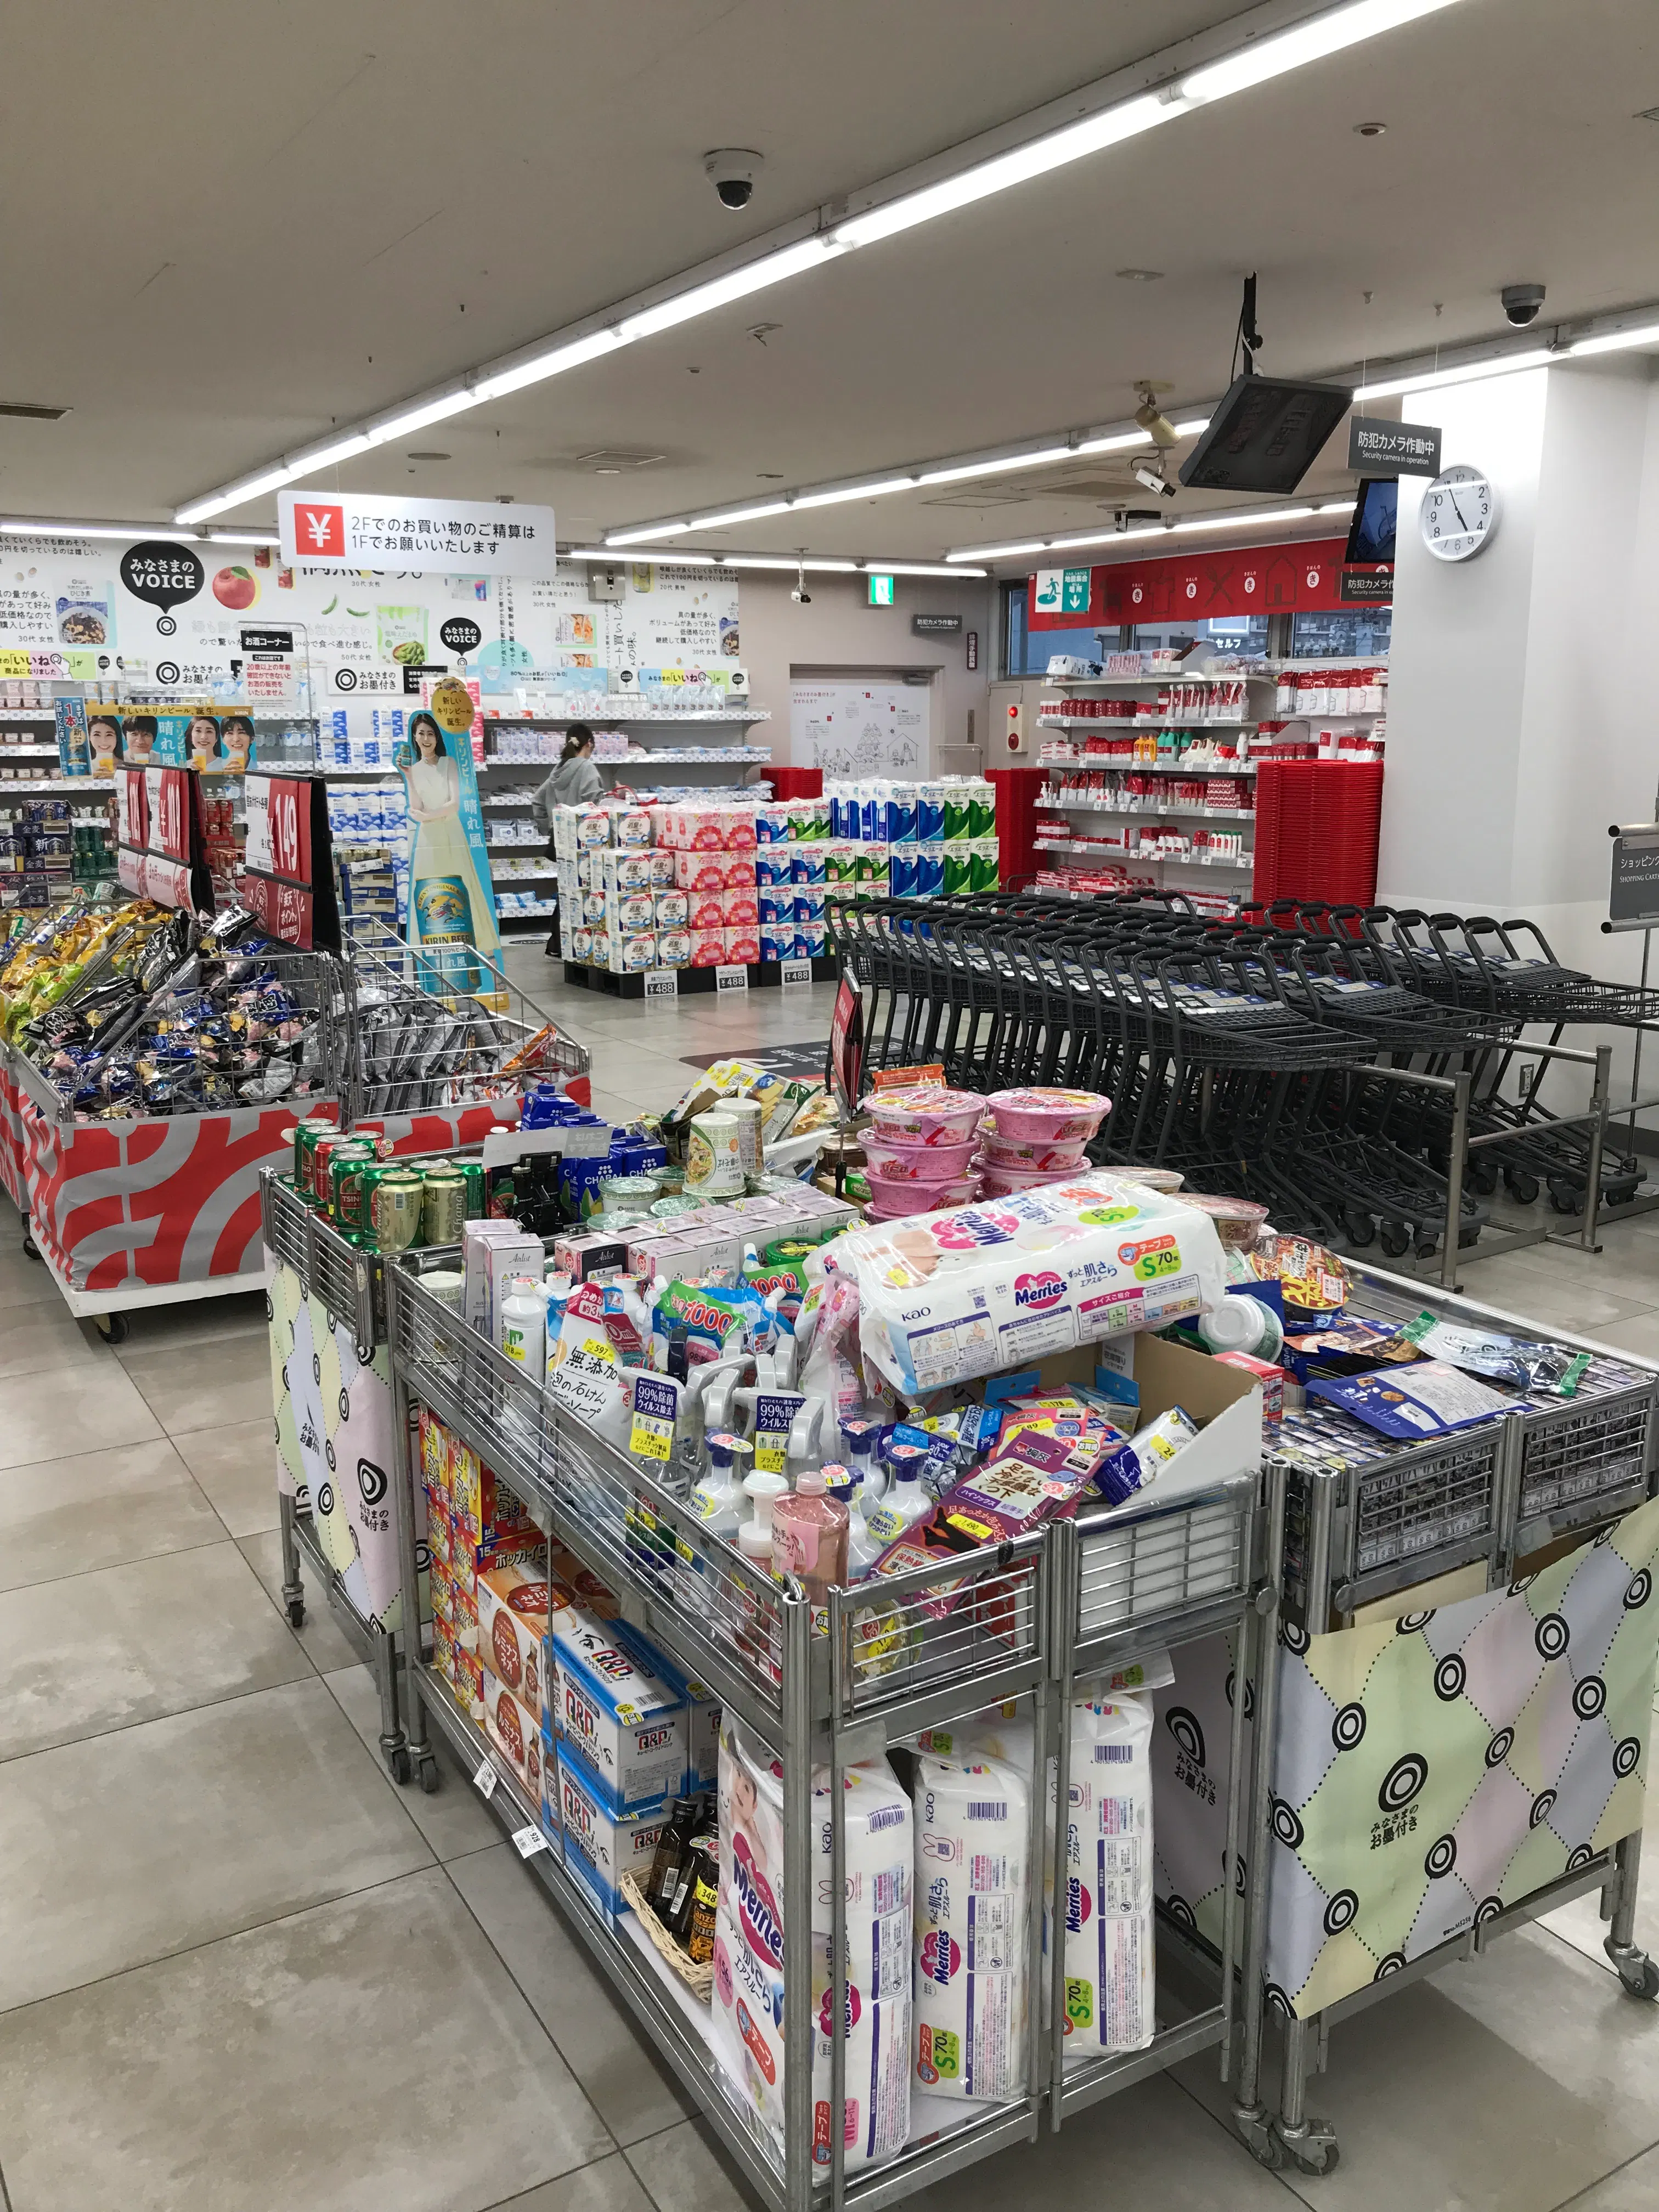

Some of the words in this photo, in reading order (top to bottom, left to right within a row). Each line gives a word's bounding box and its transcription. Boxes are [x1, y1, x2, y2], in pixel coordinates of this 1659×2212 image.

[1358, 431, 1434, 456] 防犯カメラ作動中
[1362, 450, 1381, 461] Security
[1434, 495, 1443, 506] 10
[1481, 503, 1488, 515] 3
[1431, 511, 1437, 522] 9
[352, 516, 535, 539] 2Fでのお買い物のご精算は
[1477, 521, 1483, 531] 4
[1434, 527, 1440, 538] 8
[0, 537, 92, 548] くていくらでも飲めそう。
[352, 534, 500, 555] 1Fでお願いいたします
[130, 558, 194, 573] みなさまの
[132, 574, 196, 589] VOICE
[444, 626, 477, 635] みなさまの
[245, 637, 290, 646] お酒コーナー
[445, 635, 477, 644] VOICE
[1215, 639, 1241, 649] セルフ
[5, 667, 57, 675] 商品になりました
[182, 665, 223, 674] みなさまの
[359, 672, 396, 680] みなさまの
[359, 680, 397, 690] お墨付き
[117, 706, 219, 715] 新しいキリンビール、誕生。
[158, 720, 177, 768] 晴れ風
[425, 935, 449, 945] KIRIN
[1015, 1281, 1068, 1306] Merries
[566, 1346, 618, 1381] 無添加
[638, 1386, 674, 1407] 99%除菌
[961, 1489, 997, 1506] ハイソックス
[1370, 1804, 1419, 1834] みなさまの
[1370, 1815, 1418, 1850] お墨付き
[934, 1929, 950, 1986] Merries
